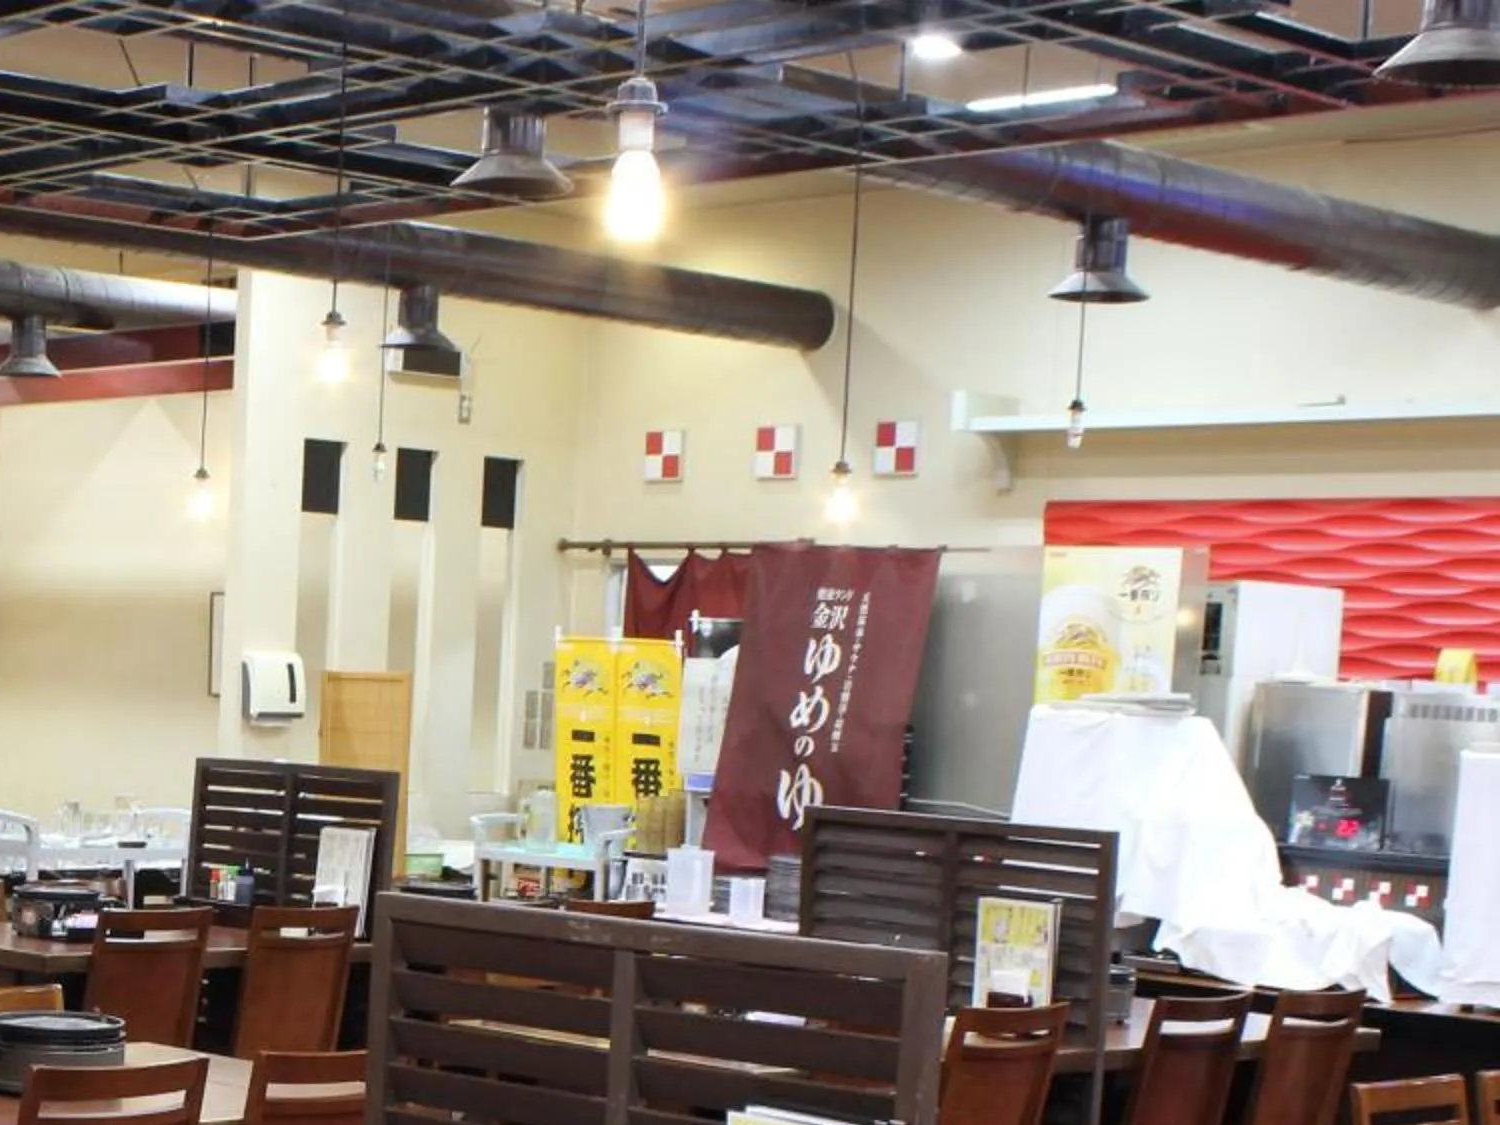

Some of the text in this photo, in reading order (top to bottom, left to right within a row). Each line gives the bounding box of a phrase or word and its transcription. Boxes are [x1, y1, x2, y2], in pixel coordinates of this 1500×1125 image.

[811, 602, 849, 631] 金沢
[777, 633, 842, 831] ゆめのゆ
